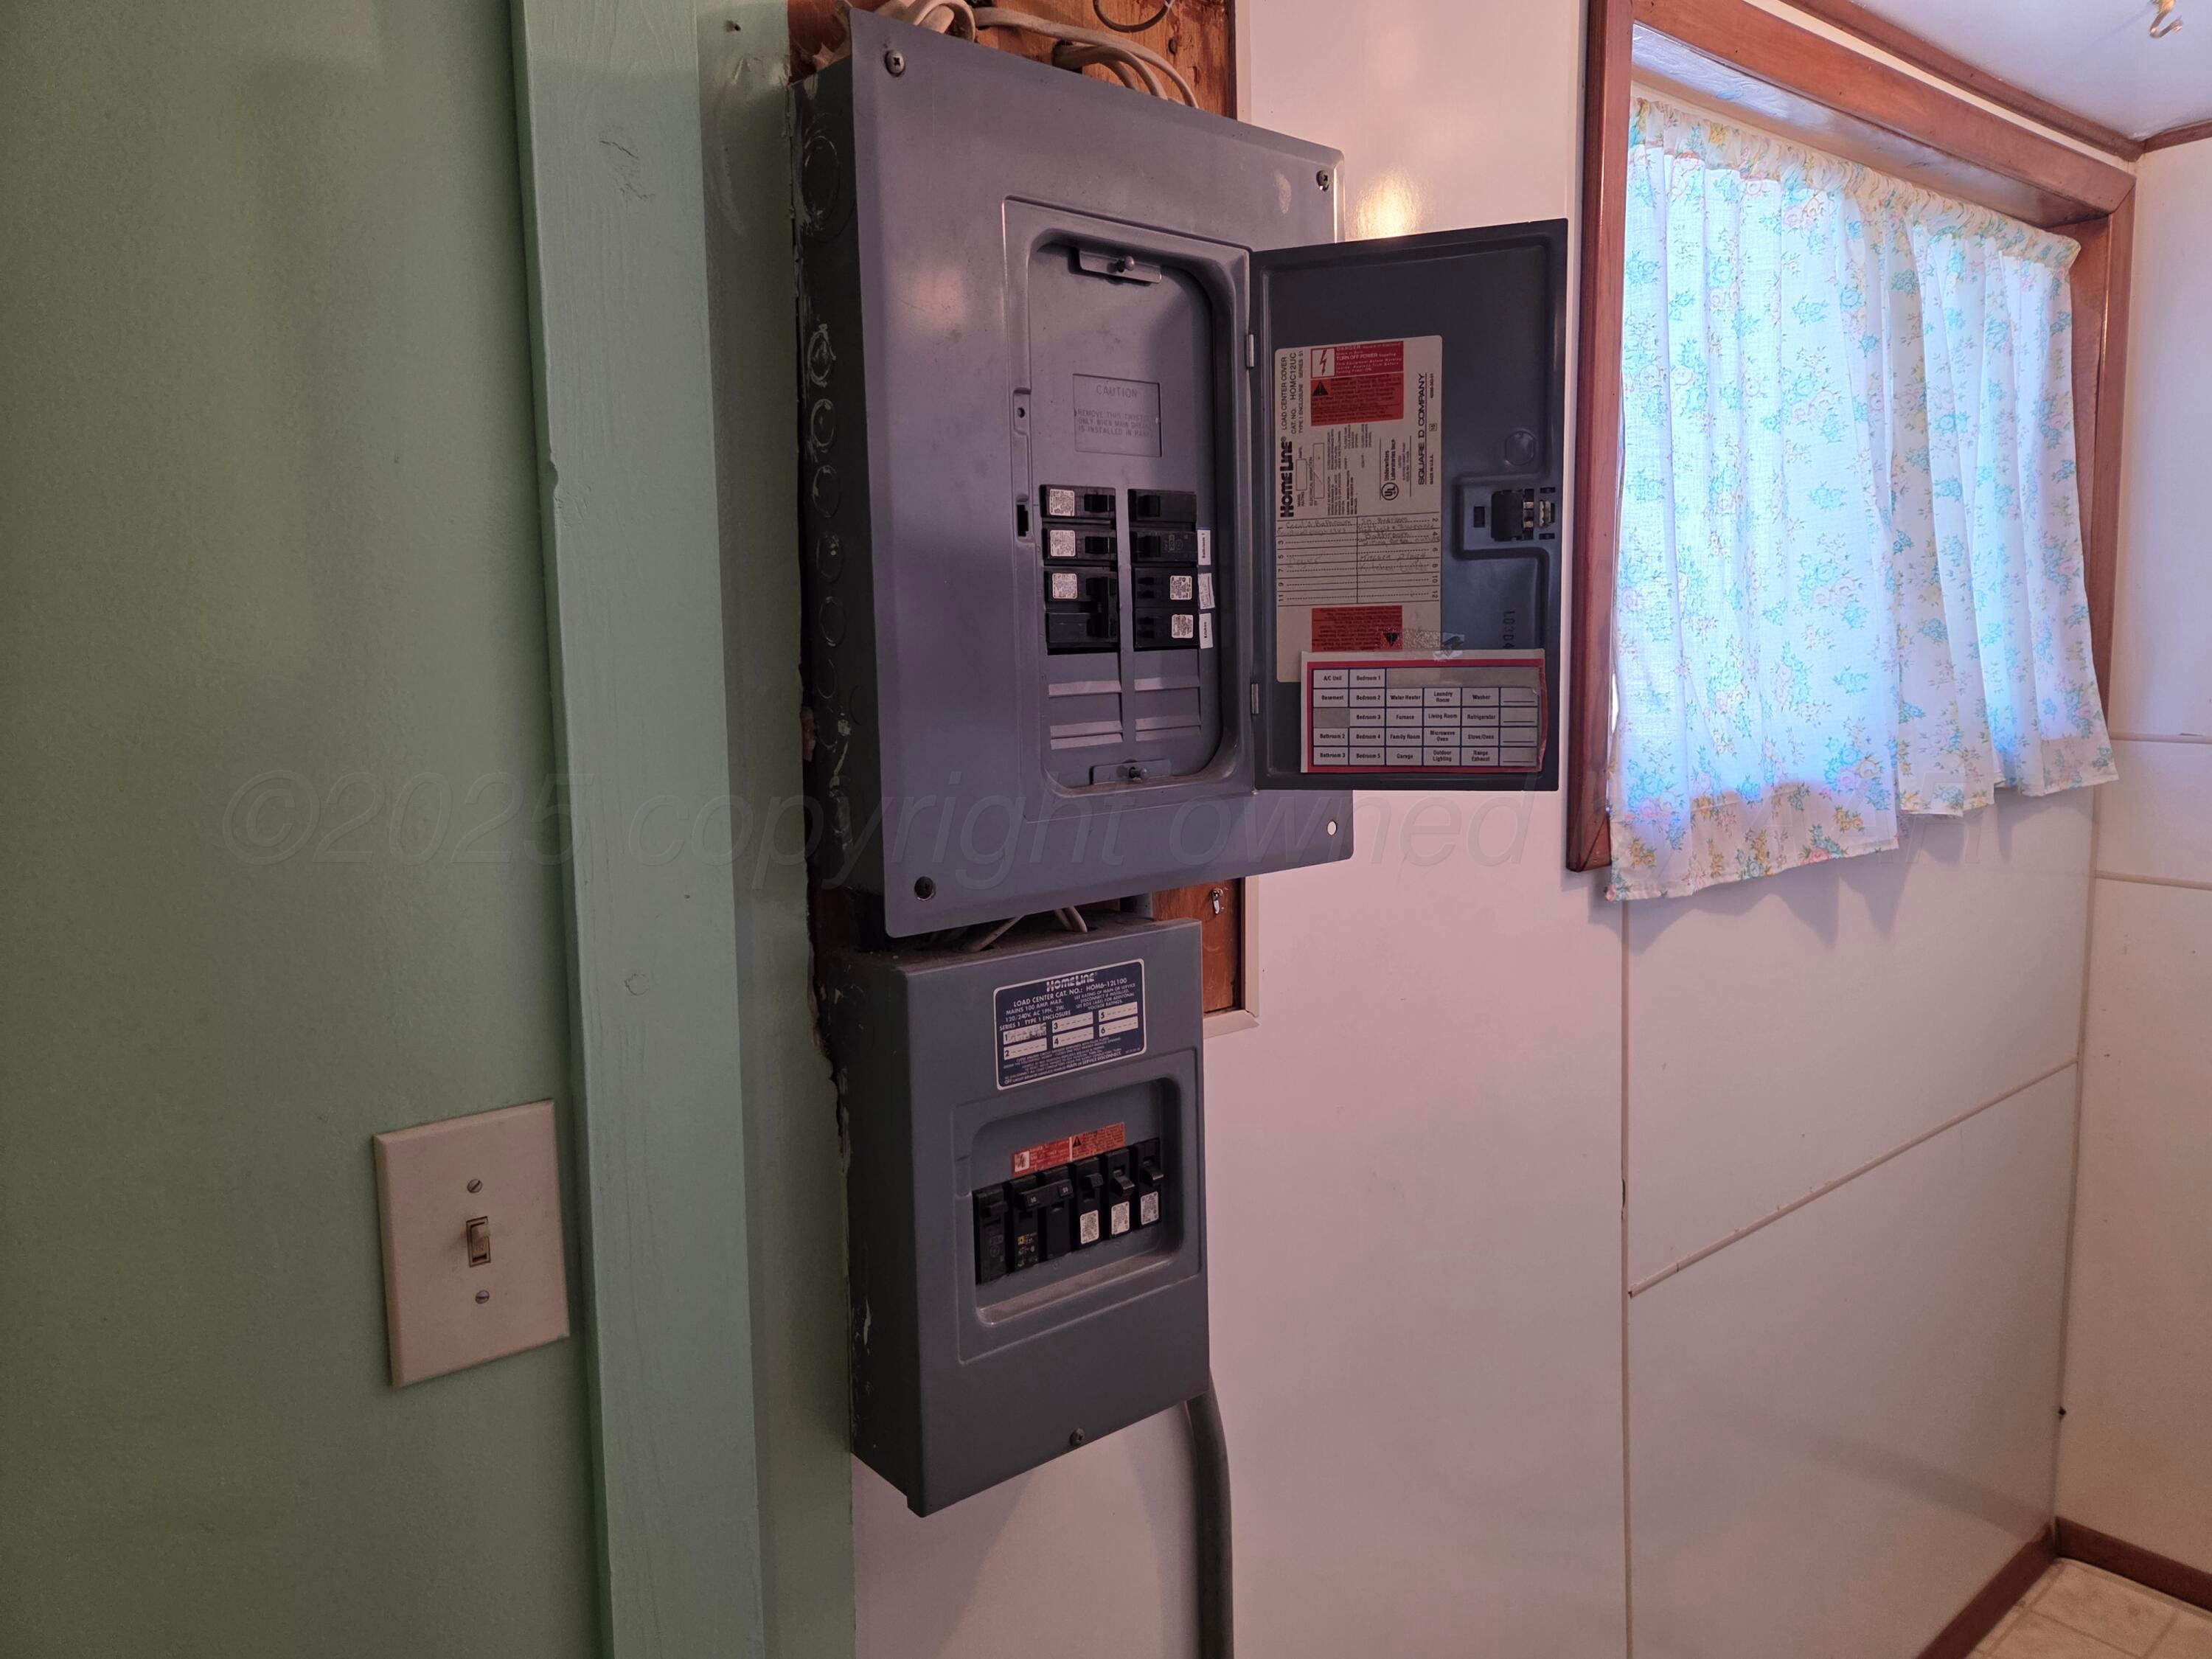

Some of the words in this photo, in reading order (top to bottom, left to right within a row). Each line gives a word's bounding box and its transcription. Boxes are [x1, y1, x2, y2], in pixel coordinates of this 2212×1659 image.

[1096, 384, 1138, 399] CAUTION
[1078, 408, 1104, 419] REMOVE
[1107, 411, 1121, 420] THIS
[1088, 426, 1122, 435] INSTALLED
[1418, 430, 1425, 438] D
[1014, 998, 1031, 1007] LOAD
[1032, 993, 1054, 1004] CENTER
[1055, 990, 1068, 998] CAT.
[1085, 978, 1127, 992] HOM6-12L100
[1080, 994, 1105, 1004] DISCONNECT
[1006, 1007, 1023, 1015] MAINS
[1100, 1011, 1105, 1019] 5
[999, 1023, 1016, 1031] SERIES
[1043, 1009, 1071, 1021] ENCLOSURE
[1053, 1022, 1059, 1030] 3
[1101, 1026, 1106, 1034] 6
[1053, 1037, 1059, 1046] 4
[1004, 1049, 1010, 1057] 2
[1082, 1057, 1097, 1065] SERVICE
